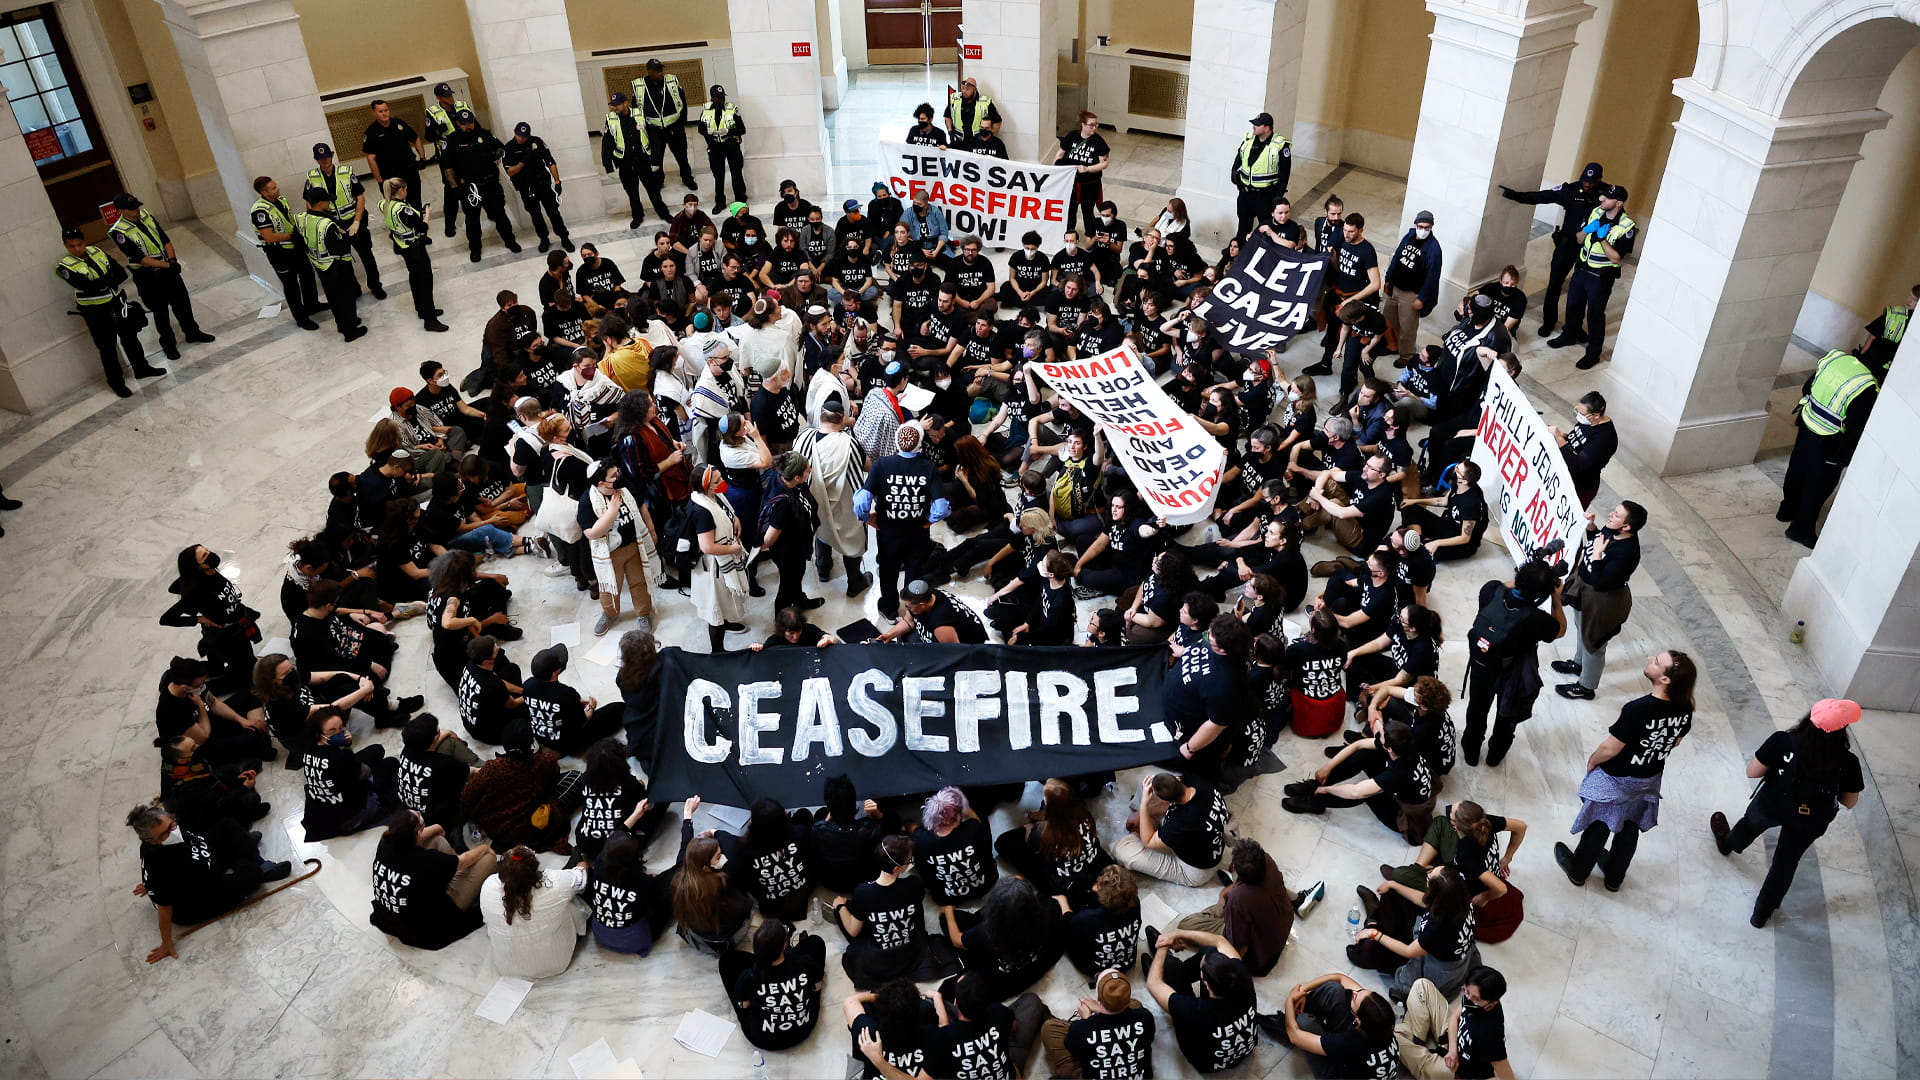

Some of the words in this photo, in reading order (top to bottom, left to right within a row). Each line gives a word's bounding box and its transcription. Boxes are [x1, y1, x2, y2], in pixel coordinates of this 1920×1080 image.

[965, 48, 981, 56] EXIT
[902, 154, 981, 182] JEWS
[987, 165, 1050, 193] SAY
[890, 176, 1064, 222] CEASEFIRE
[1350, 254, 1360, 262] IN
[1243, 246, 1323, 297] LET
[1212, 277, 1309, 330] GAZA
[1043, 351, 1132, 379] LIVING
[1098, 370, 1145, 394] FOR
[1072, 392, 1148, 412] HELL
[1092, 409, 1158, 424] LIKE
[1129, 436, 1174, 454] AND
[1477, 405, 1528, 498] NEVER
[1493, 383, 1535, 450] PHILLY
[1532, 441, 1560, 500] JEWS
[1556, 494, 1577, 539] SAY
[886, 474, 927, 486] JEWS
[890, 485, 921, 495] SAY
[1153, 469, 1204, 491] THE
[885, 494, 926, 503] CEASE
[891, 502, 920, 511] FIRE
[1500, 484, 1511, 514] IS
[886, 509, 924, 520] NOW
[1190, 647, 1200, 675] OUR
[1201, 663, 1211, 676] IN
[1302, 657, 1342, 671] JEWS
[1307, 668, 1337, 680] SAY
[525, 696, 561, 713] JEWS
[684, 666, 1174, 766] CEASEFIRE.
[1645, 714, 1689, 730] JEWS
[1650, 727, 1682, 741] SAY
[304, 765, 323, 781] SAY
[399, 755, 432, 778] JEWS
[398, 767, 423, 788] SAY
[584, 809, 622, 819] CEASE
[586, 798, 616, 810] SAY
[1206, 788, 1222, 832] JEWS
[587, 820, 615, 830] FIRE
[753, 842, 798, 869] JEWS
[927, 845, 975, 866] JEWS
[374, 861, 412, 887] JEWS
[759, 862, 804, 885] CEASE
[760, 857, 794, 878] SAY
[935, 862, 981, 883] CEASE
[936, 858, 971, 876] SAY
[593, 880, 637, 902] JEWS
[944, 874, 986, 897] NOW
[594, 892, 628, 913] SAY
[868, 904, 916, 923] JEWS
[875, 918, 911, 935] SAY
[1095, 919, 1140, 944] JEWS
[1102, 934, 1137, 954] SAY
[757, 973, 808, 996] JEWS
[765, 989, 804, 1008] SAY
[762, 1011, 811, 1033] NOW
[770, 1010, 806, 1023] FIRE
[1212, 1006, 1256, 1039] JEWS
[952, 1026, 1000, 1058] JEWS
[1087, 1022, 1144, 1045] JEWS
[1221, 1022, 1254, 1050] SAY
[882, 1049, 924, 1068] EWS
[961, 1043, 999, 1071] SAY
[1090, 1049, 1145, 1069] CEASE
[1096, 1038, 1139, 1059] SAY
[1366, 1038, 1400, 1067] JEW
[956, 1051, 1007, 1080] CEASE
[1099, 1062, 1138, 1080] FIRE
